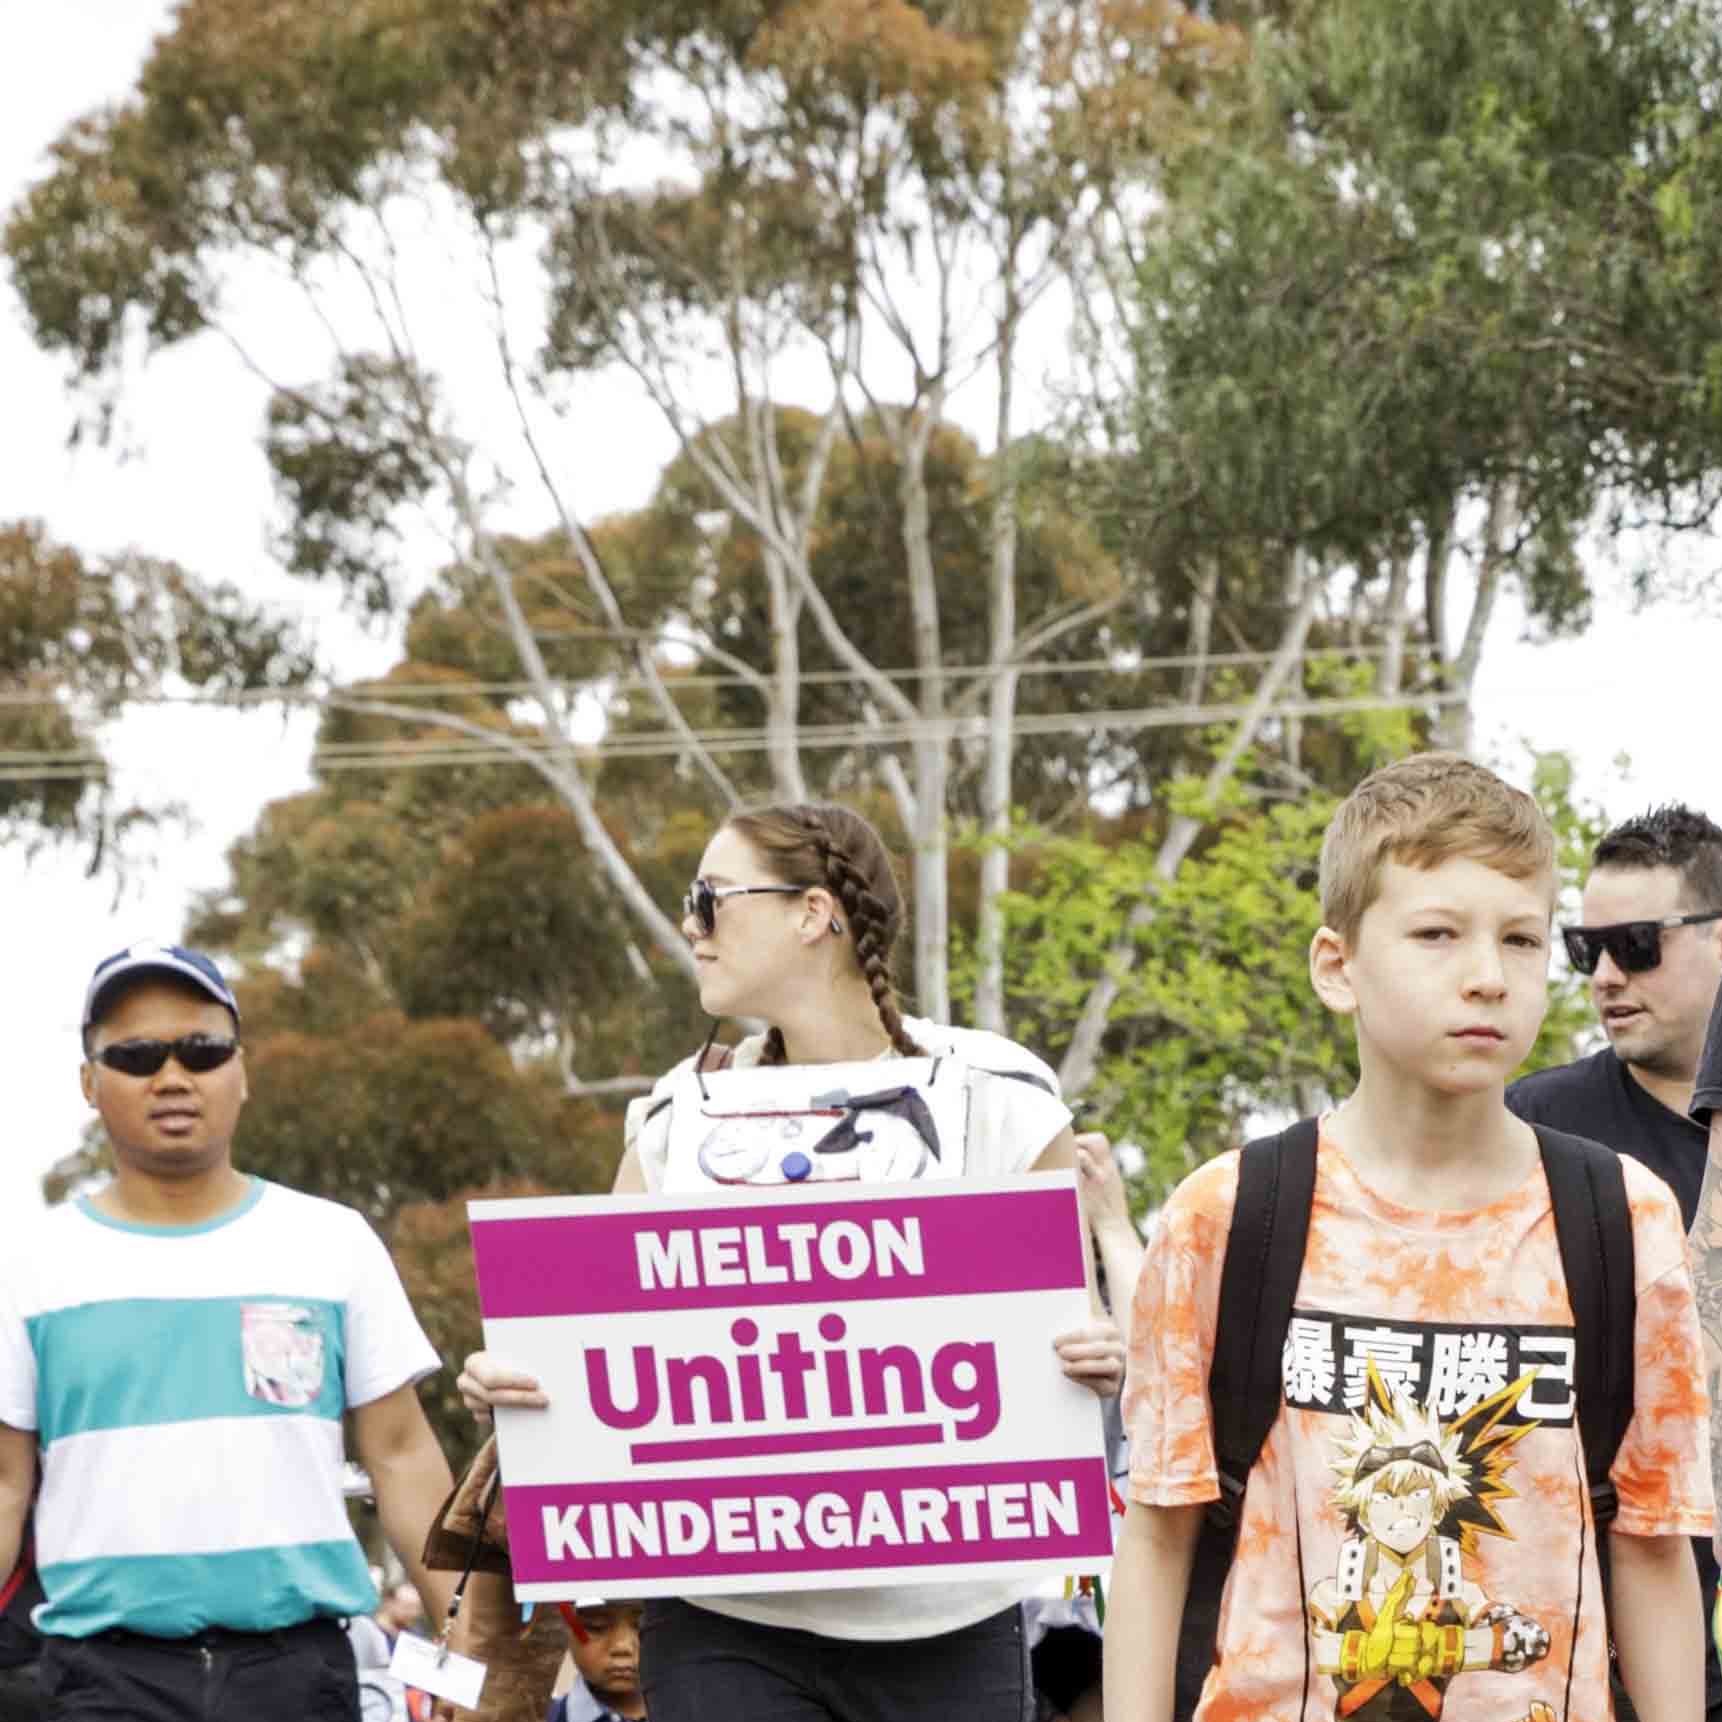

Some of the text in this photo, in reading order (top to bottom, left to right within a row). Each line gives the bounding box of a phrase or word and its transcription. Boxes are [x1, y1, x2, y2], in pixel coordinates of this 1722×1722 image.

[634, 1216, 925, 1291] MELTON
[584, 1313, 1001, 1442] Uniting
[542, 1481, 1080, 1561] KINDERGARTEN
